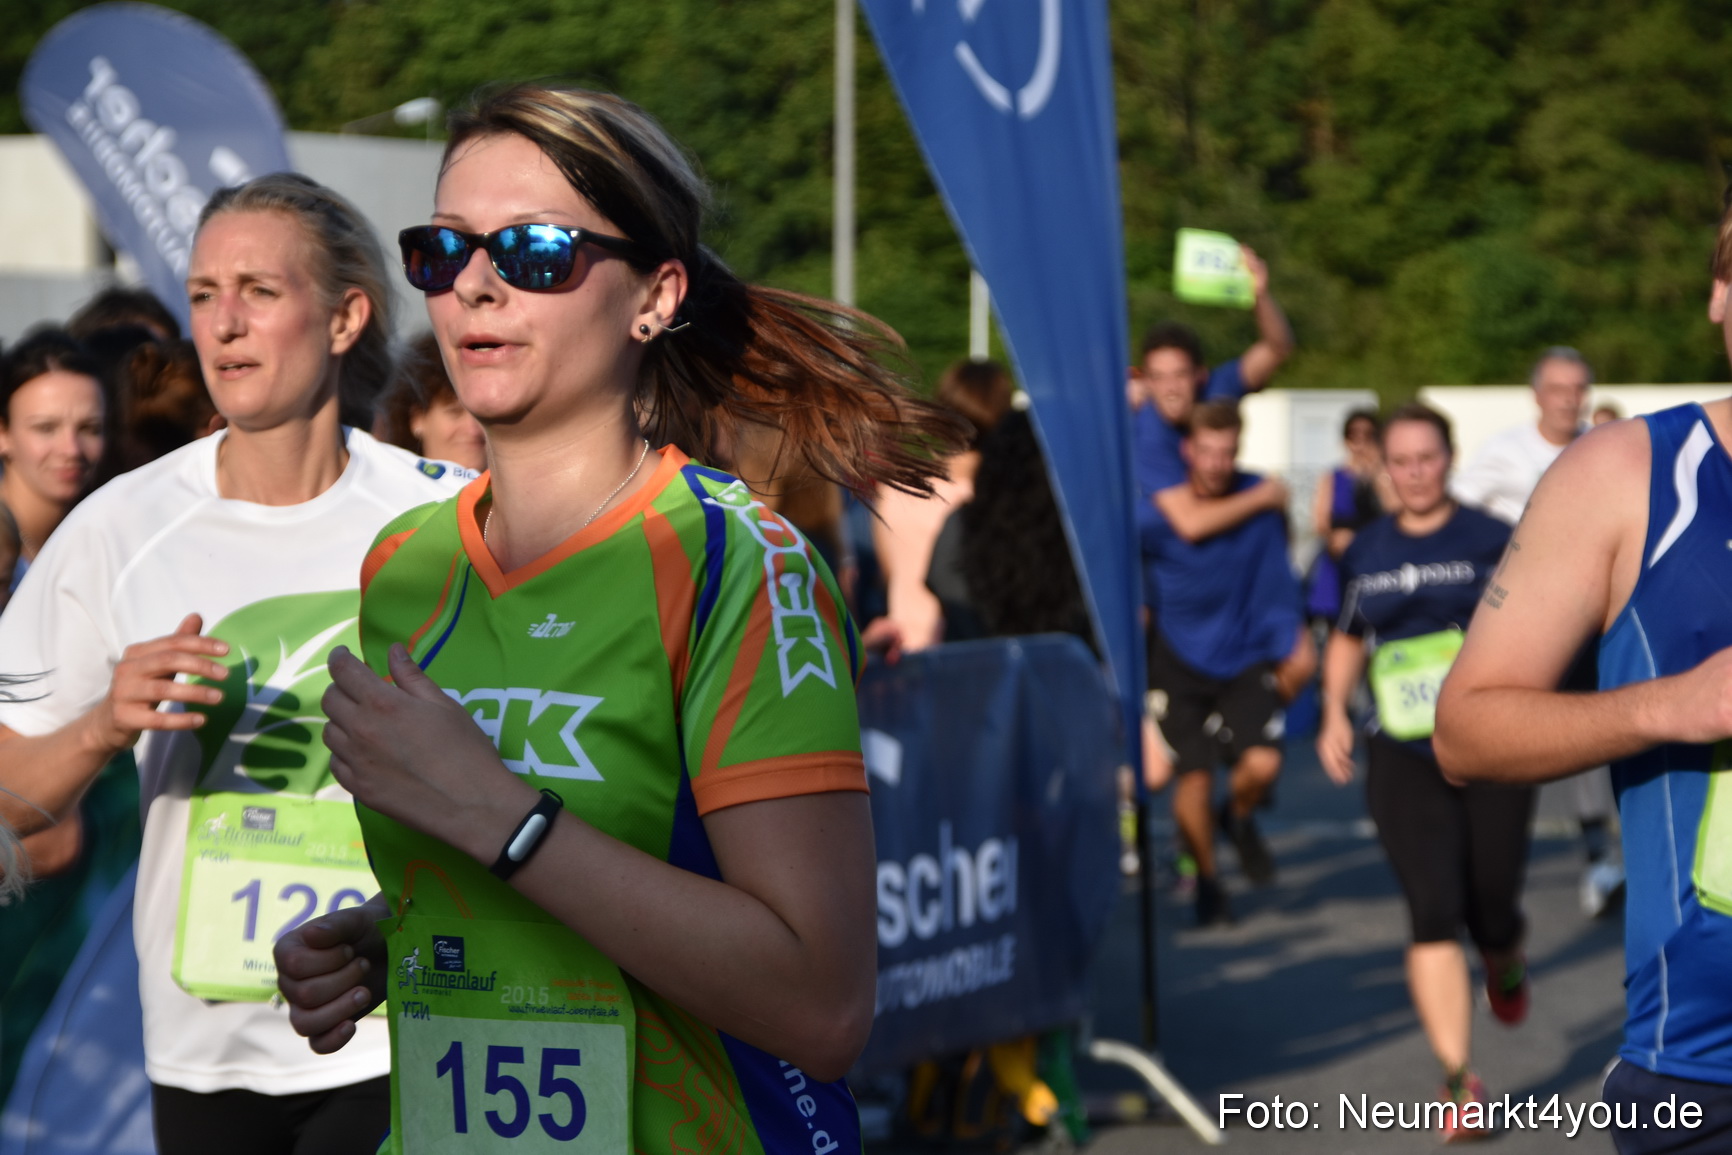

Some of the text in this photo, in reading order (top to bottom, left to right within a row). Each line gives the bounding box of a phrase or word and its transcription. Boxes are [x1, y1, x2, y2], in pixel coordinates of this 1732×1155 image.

[421, 966, 497, 991] firmenlauf
[501, 985, 550, 1006] 2015
[436, 1041, 587, 1141] 155
